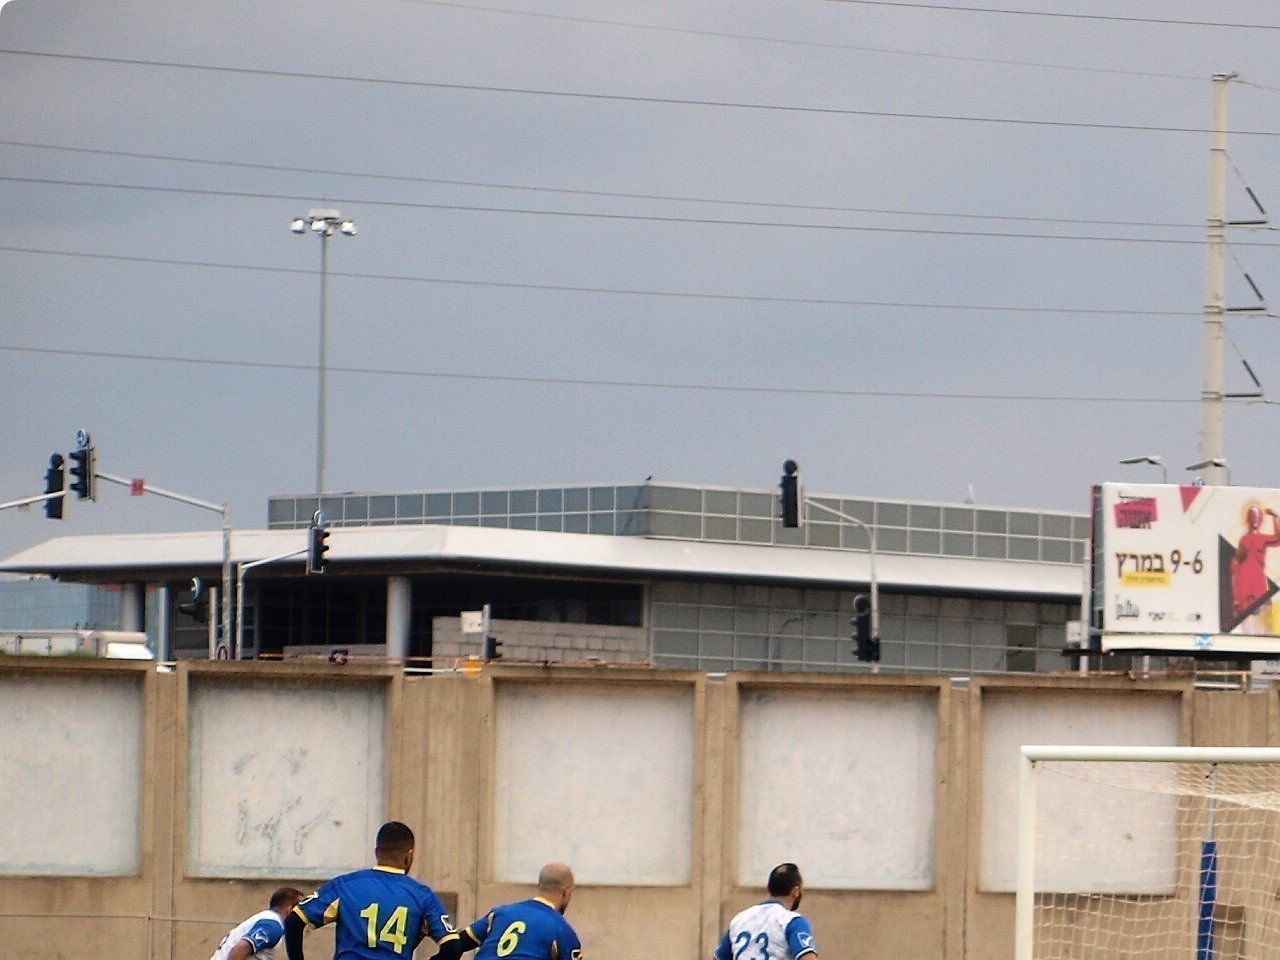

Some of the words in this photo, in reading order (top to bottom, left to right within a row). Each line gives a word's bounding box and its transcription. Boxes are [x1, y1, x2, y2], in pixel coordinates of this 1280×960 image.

[1115, 552, 1164, 578] במרץ
[359, 902, 409, 954] 14
[496, 919, 527, 958] 6
